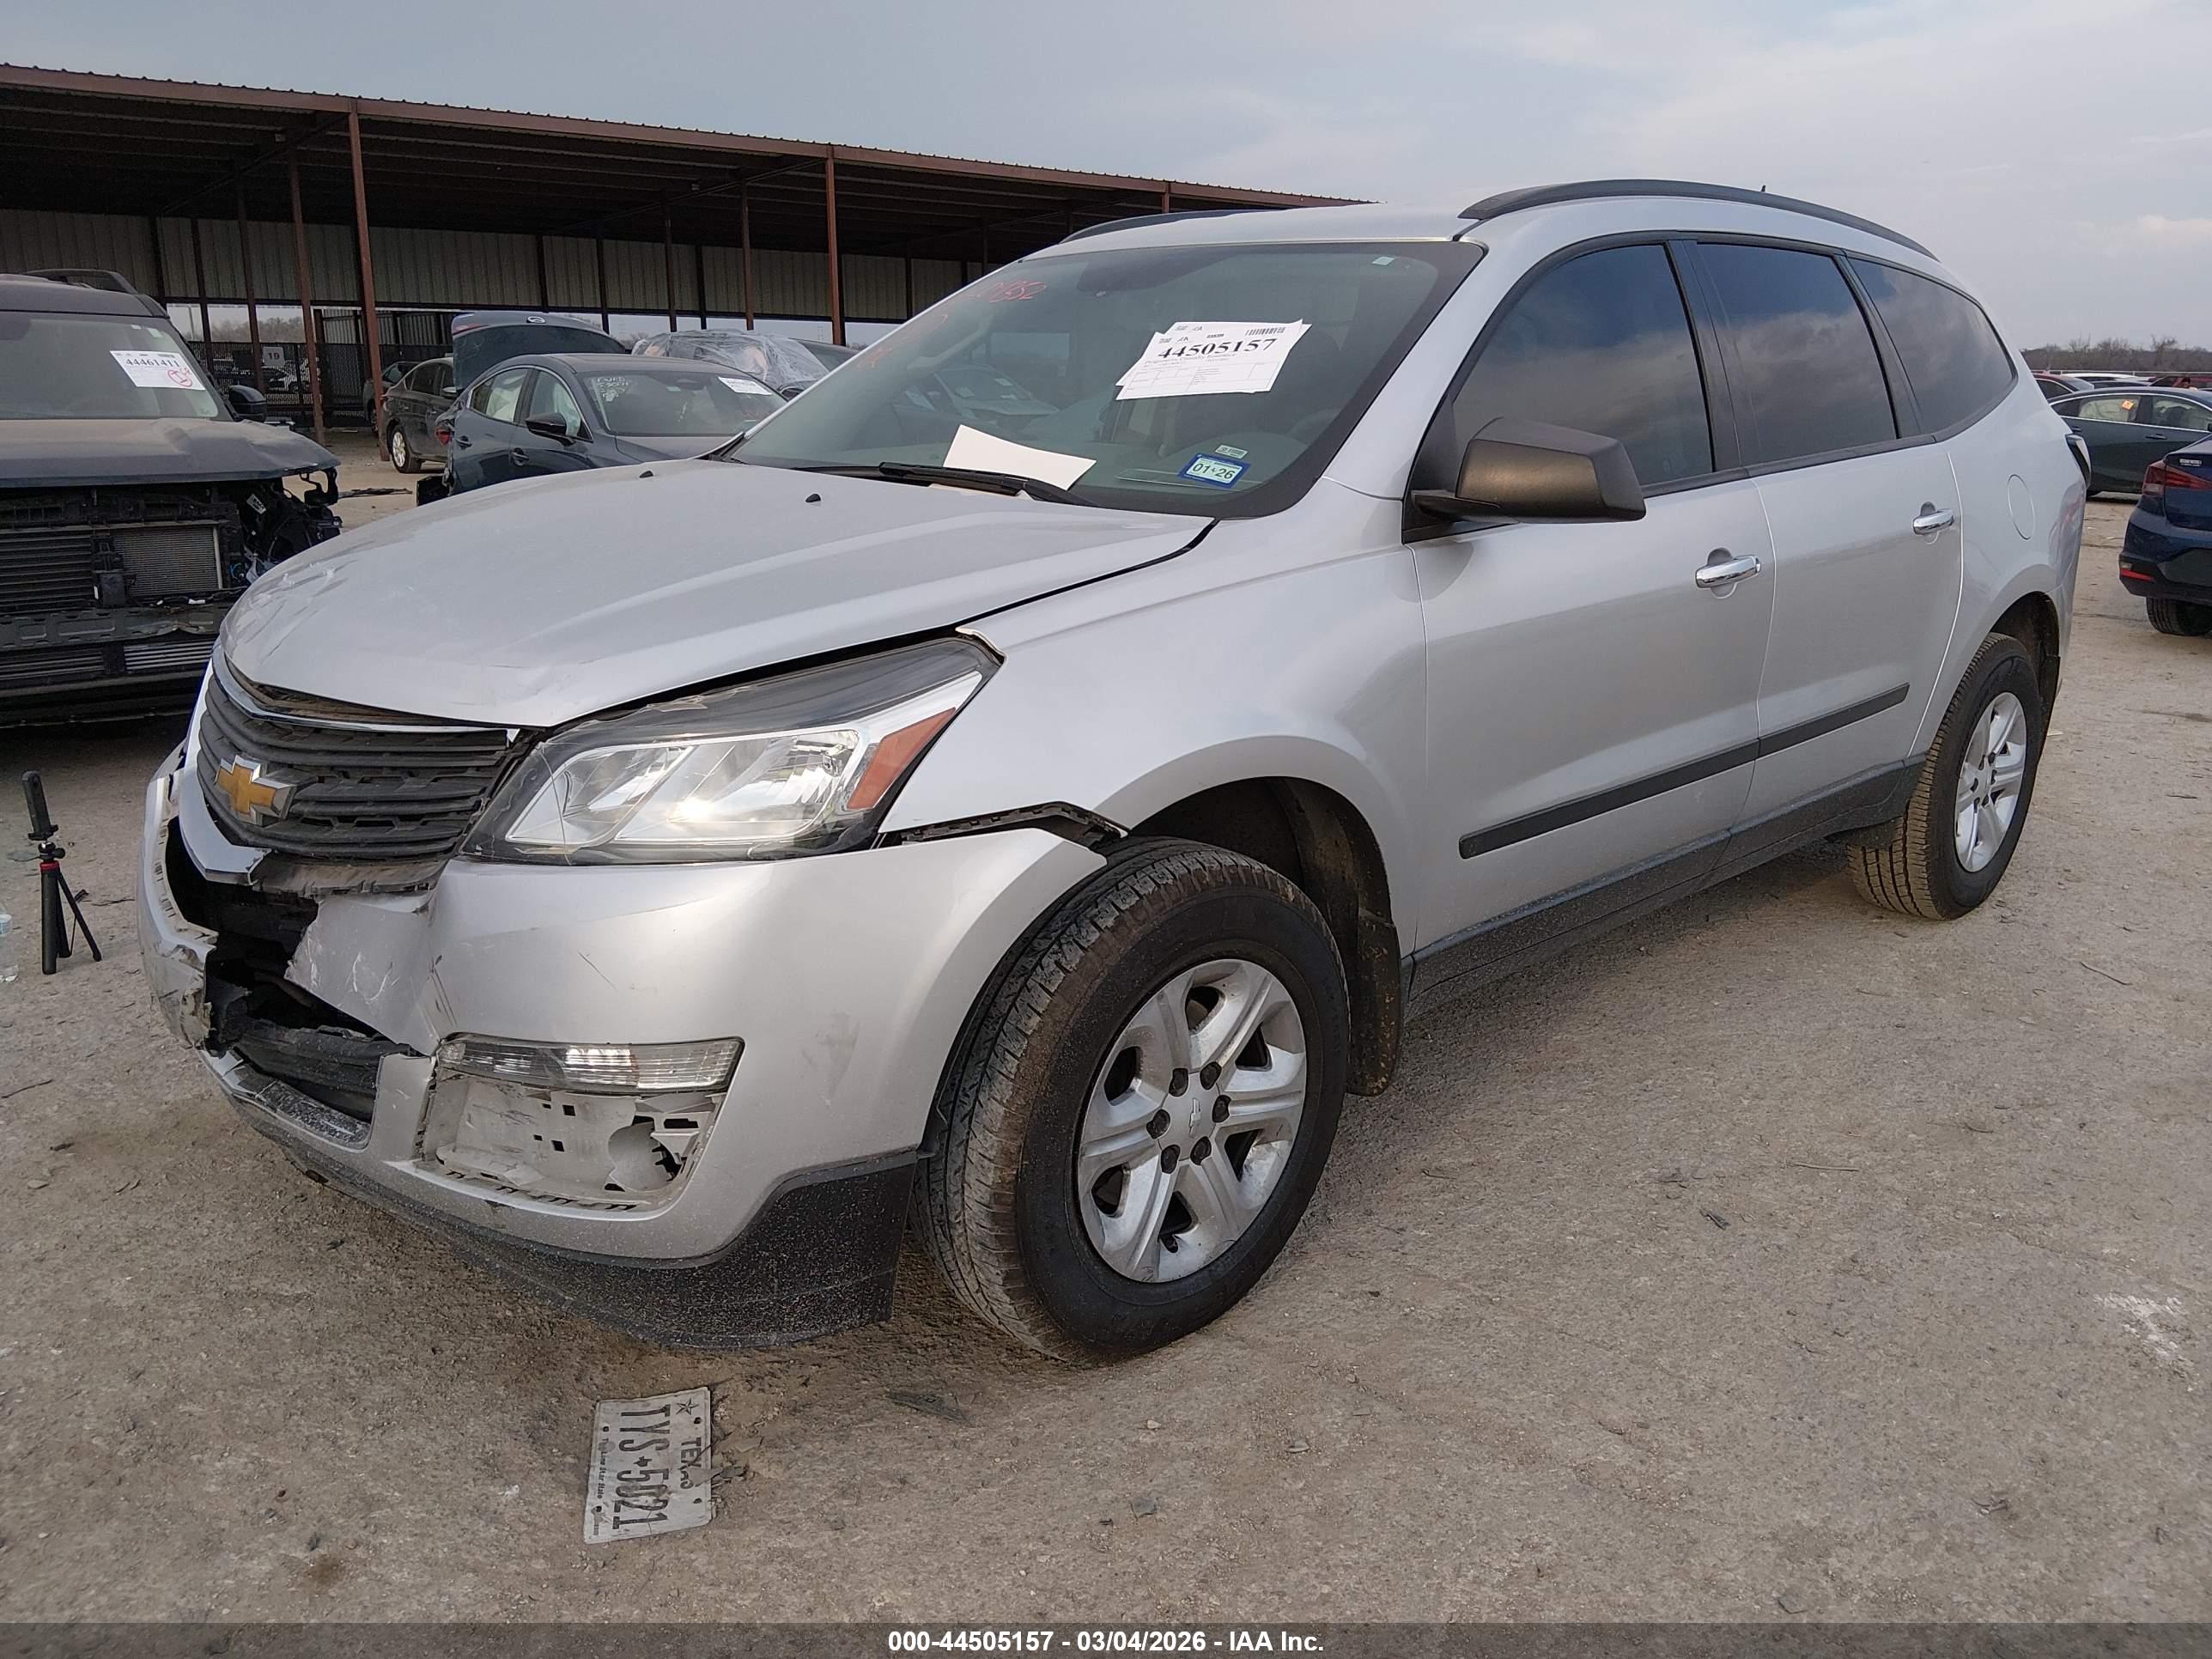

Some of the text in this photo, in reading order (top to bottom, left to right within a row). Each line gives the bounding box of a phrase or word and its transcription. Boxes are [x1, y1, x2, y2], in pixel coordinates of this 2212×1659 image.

[1158, 337, 1279, 359] 44505157
[125, 358, 180, 368] 44461411
[1192, 463, 1211, 474] 01
[1214, 468, 1236, 479] 26
